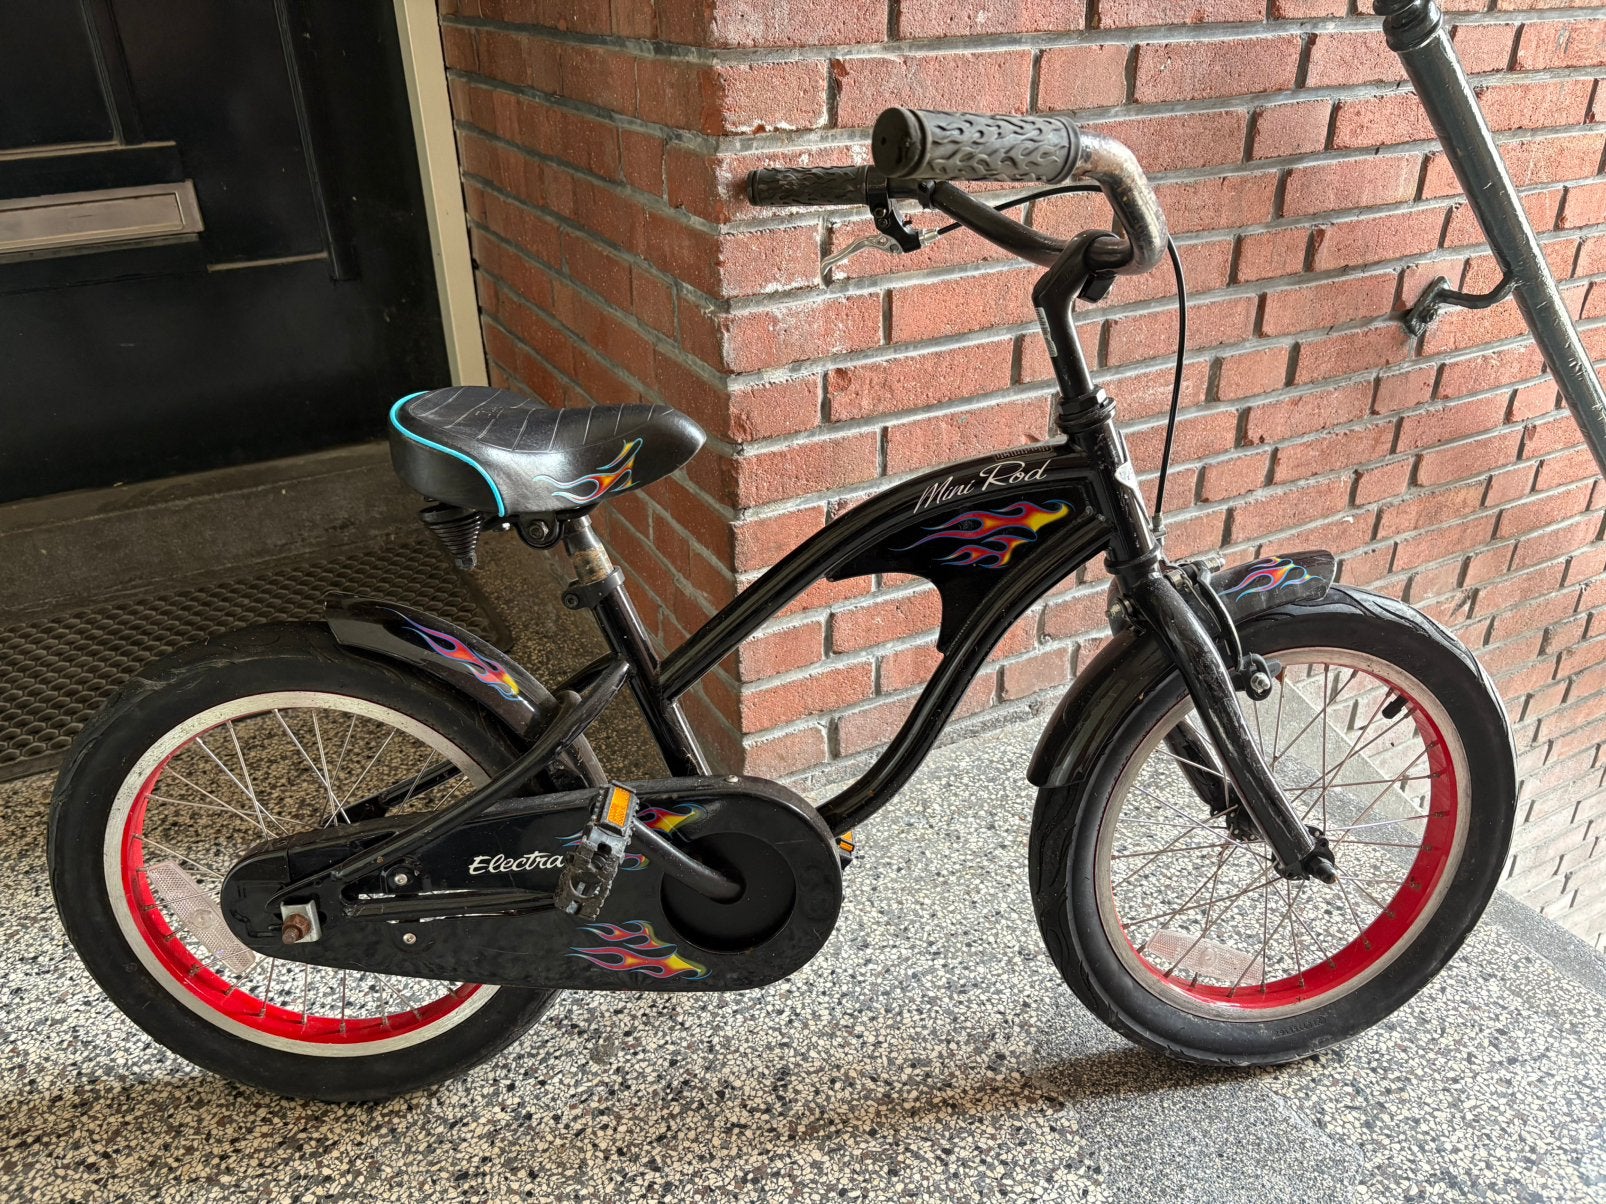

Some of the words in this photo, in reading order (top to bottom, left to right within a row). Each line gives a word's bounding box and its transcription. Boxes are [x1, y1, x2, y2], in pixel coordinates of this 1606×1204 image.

[913, 476, 975, 514] Mini
[979, 459, 1052, 492] Rod
[468, 850, 566, 875] Electra
